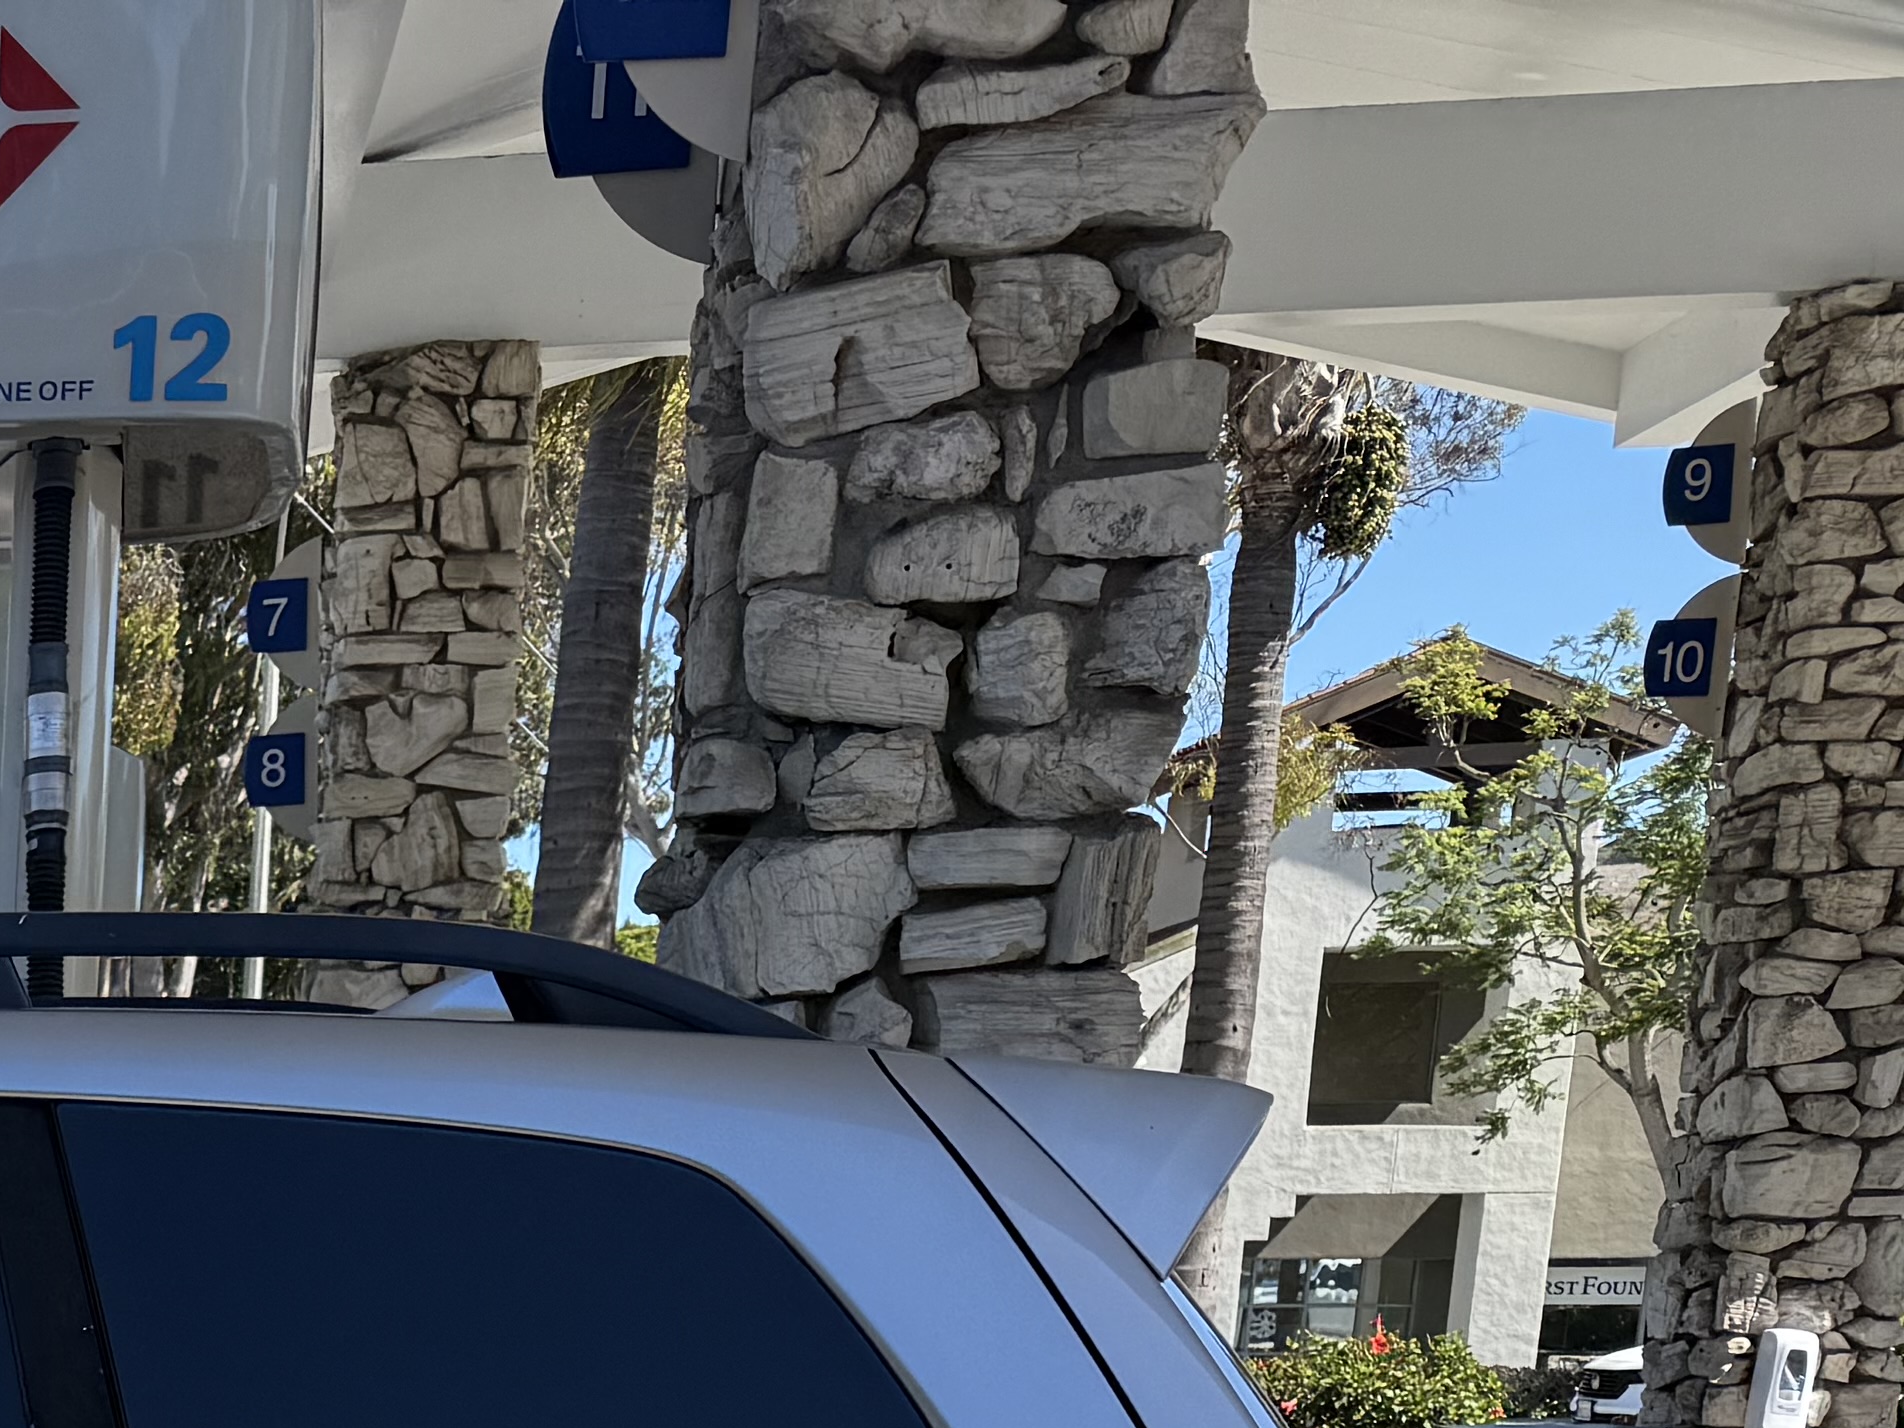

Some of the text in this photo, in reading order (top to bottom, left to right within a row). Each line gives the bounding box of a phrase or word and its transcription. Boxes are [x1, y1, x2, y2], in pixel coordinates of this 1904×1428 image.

[113, 312, 230, 402] 12
[39, 380, 94, 401] OFF
[1684, 458, 1712, 501] 9
[262, 597, 288, 637] 7
[1658, 640, 1704, 683] 10
[261, 748, 286, 787] 8
[1581, 1276, 1643, 1295] FOUN
